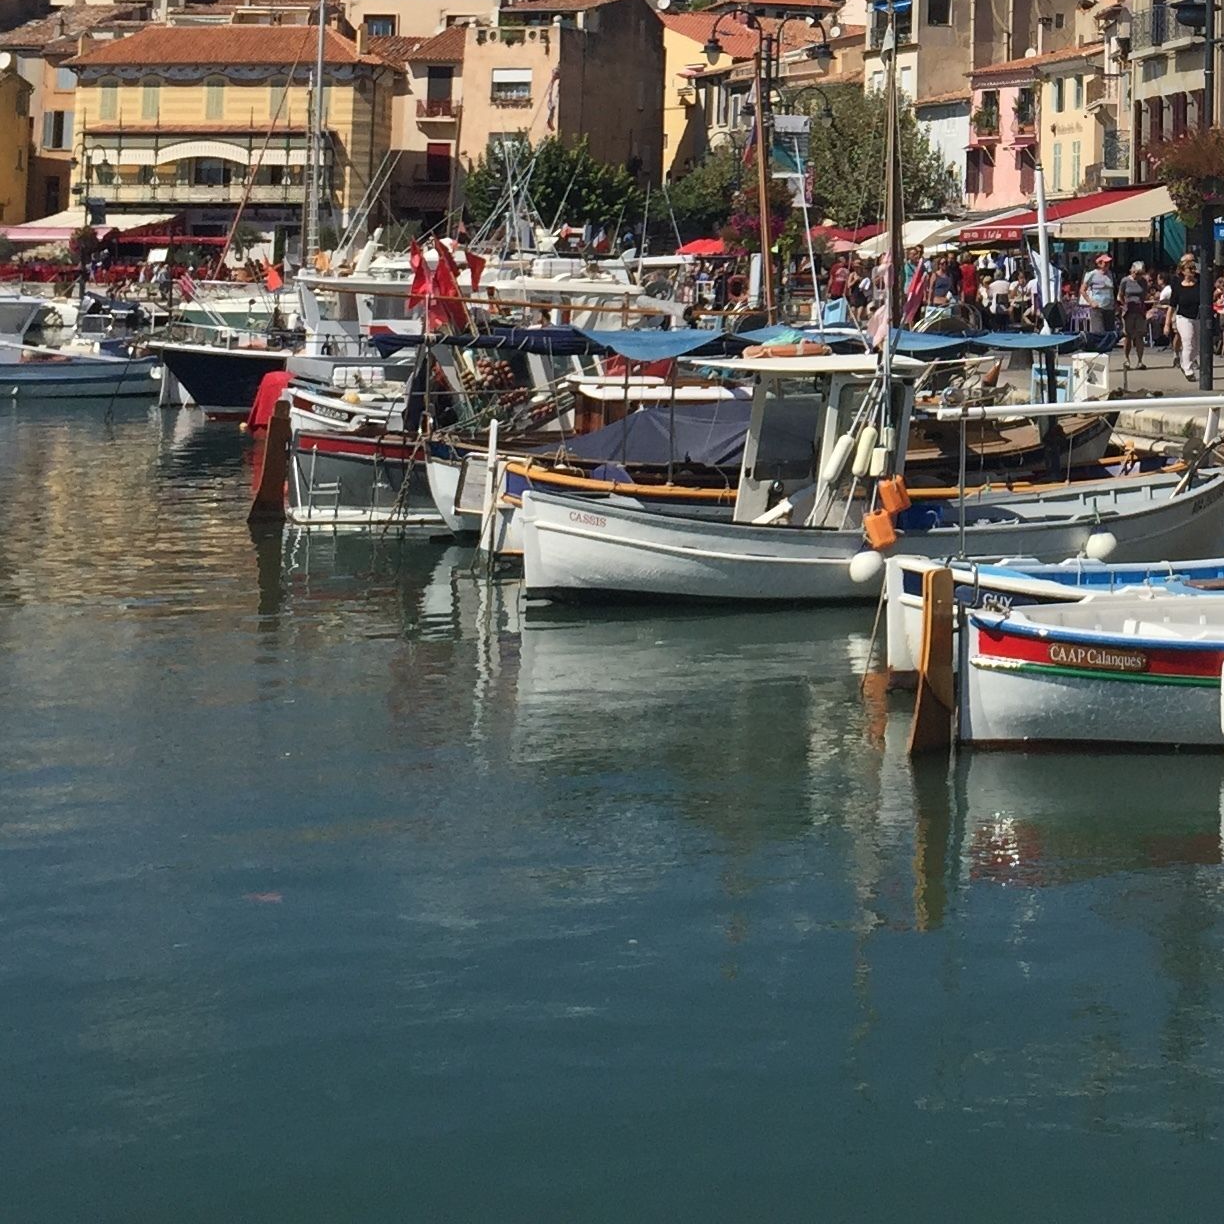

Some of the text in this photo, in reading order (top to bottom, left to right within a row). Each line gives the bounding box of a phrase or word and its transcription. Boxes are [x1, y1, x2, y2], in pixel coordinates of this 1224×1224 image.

[569, 511, 607, 528] CASSIS
[1049, 644, 1142, 670] CAAP Calanques
